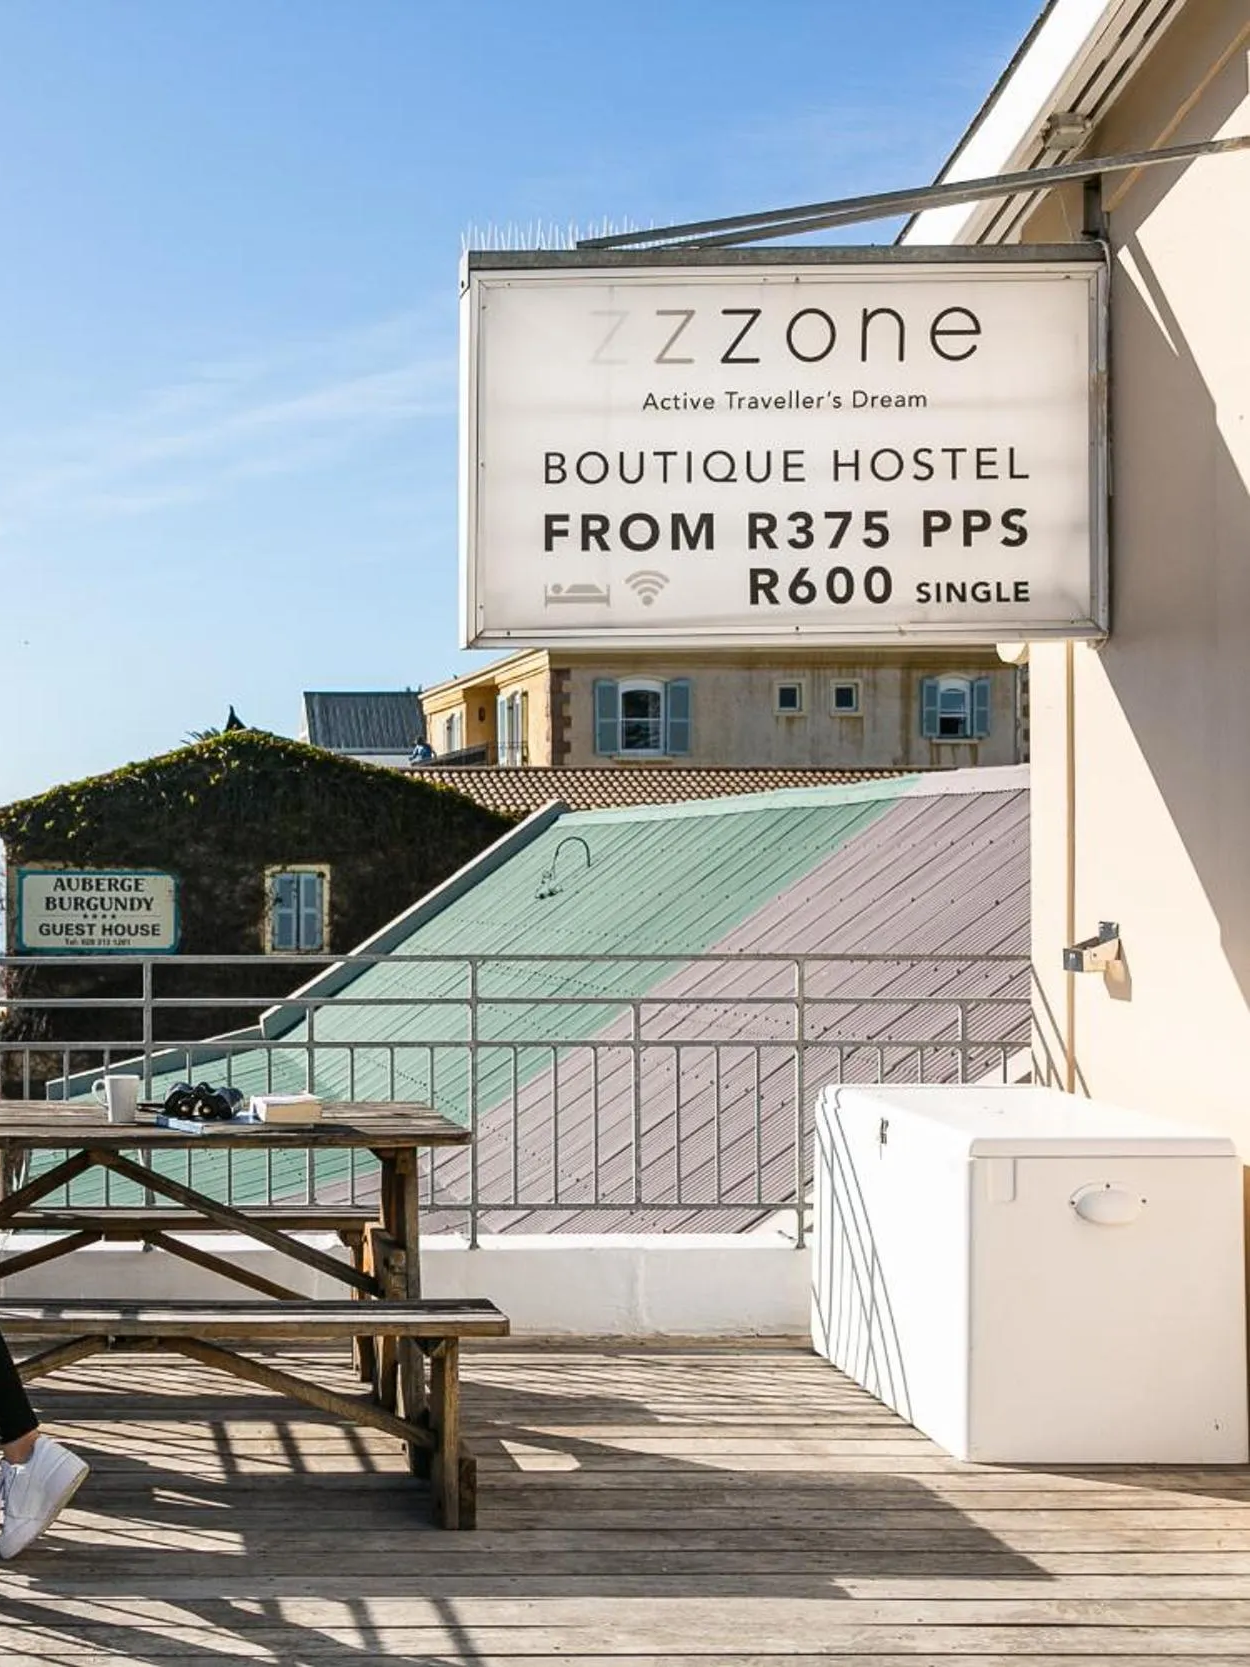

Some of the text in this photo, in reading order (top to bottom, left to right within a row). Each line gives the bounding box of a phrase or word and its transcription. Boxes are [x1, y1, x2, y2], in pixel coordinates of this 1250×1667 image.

[642, 389, 929, 411] Active Traveller's Dream
[544, 446, 1030, 485] BOUTIQUE HOSTEL
[544, 507, 1029, 552] FROM R375 PPS
[749, 565, 1031, 606] R600 SINGLE
[52, 877, 146, 893] AUBERGE
[44, 896, 155, 912] BURGUNDY
[38, 922, 161, 937] GUEST HOUSE
